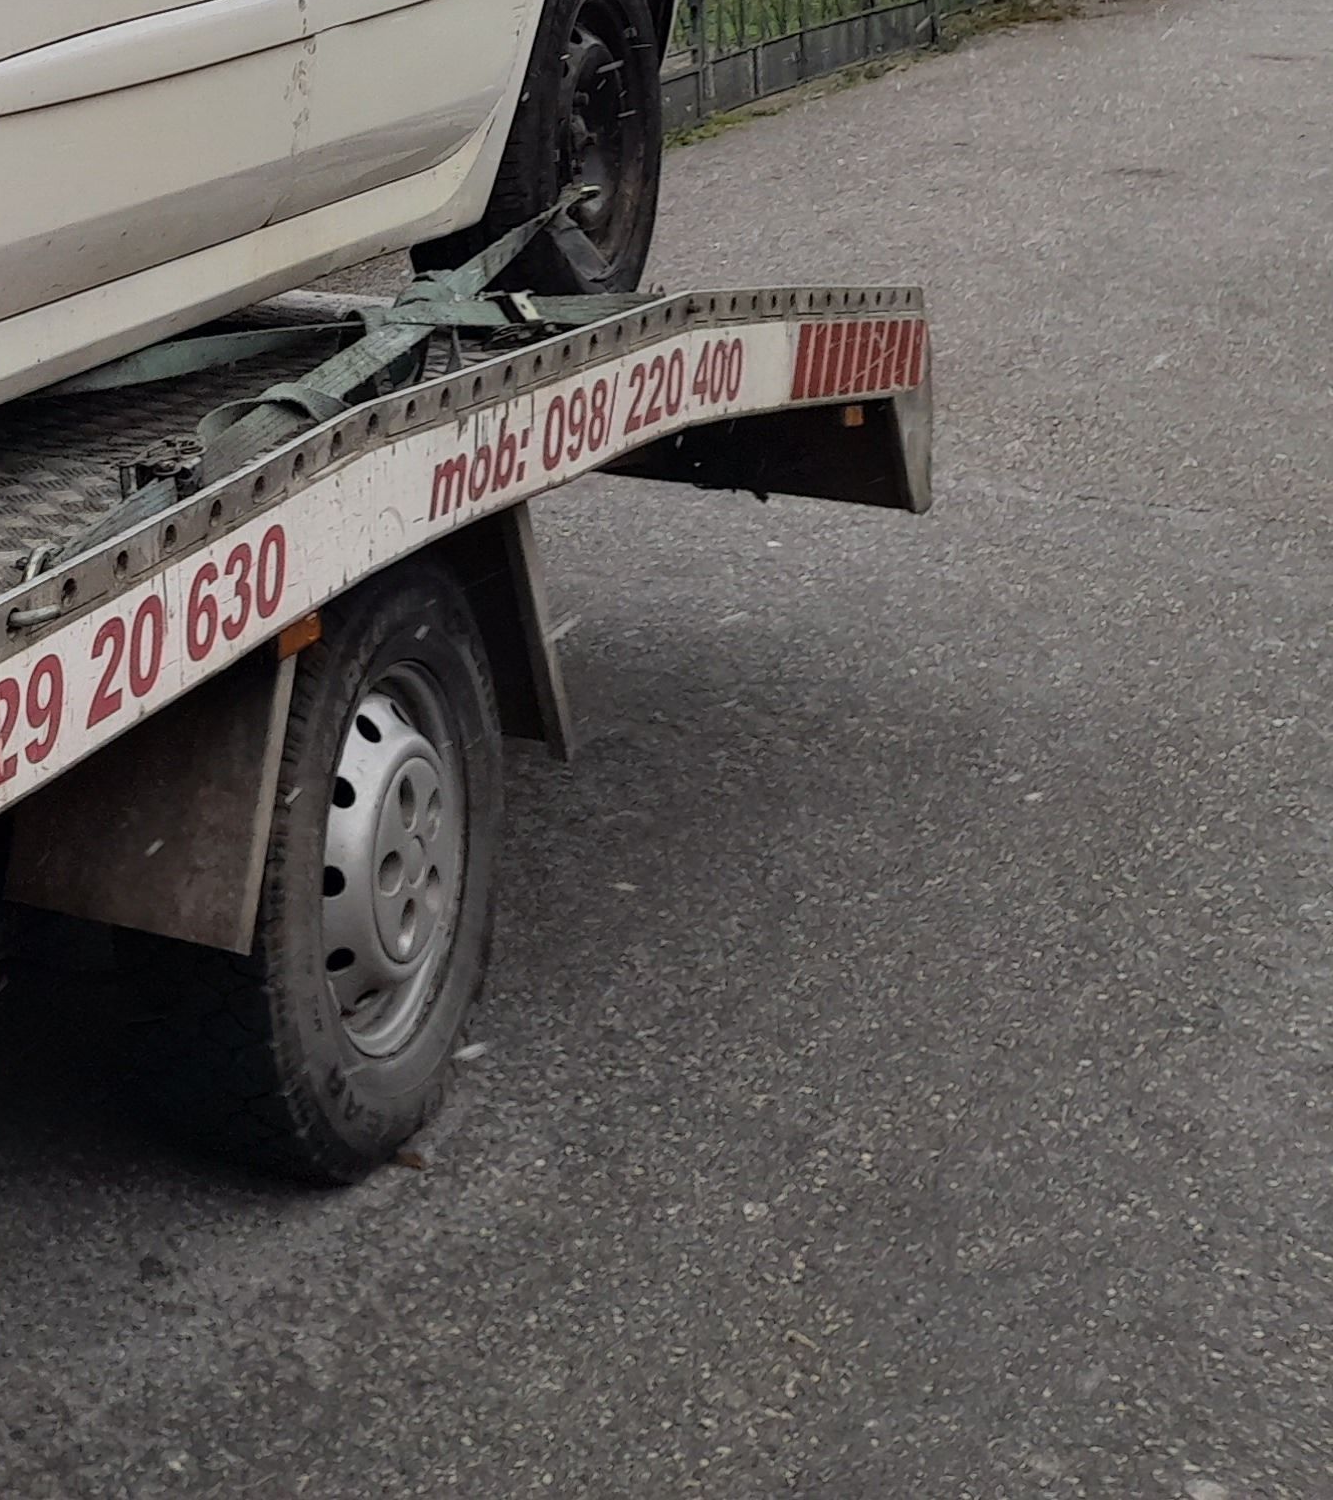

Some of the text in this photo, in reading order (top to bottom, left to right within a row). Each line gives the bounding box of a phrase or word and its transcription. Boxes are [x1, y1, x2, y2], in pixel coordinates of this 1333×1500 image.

[428, 338, 744, 522] mob: 098/ 220 400
[86, 594, 164, 730] 20
[186, 524, 287, 662] 630
